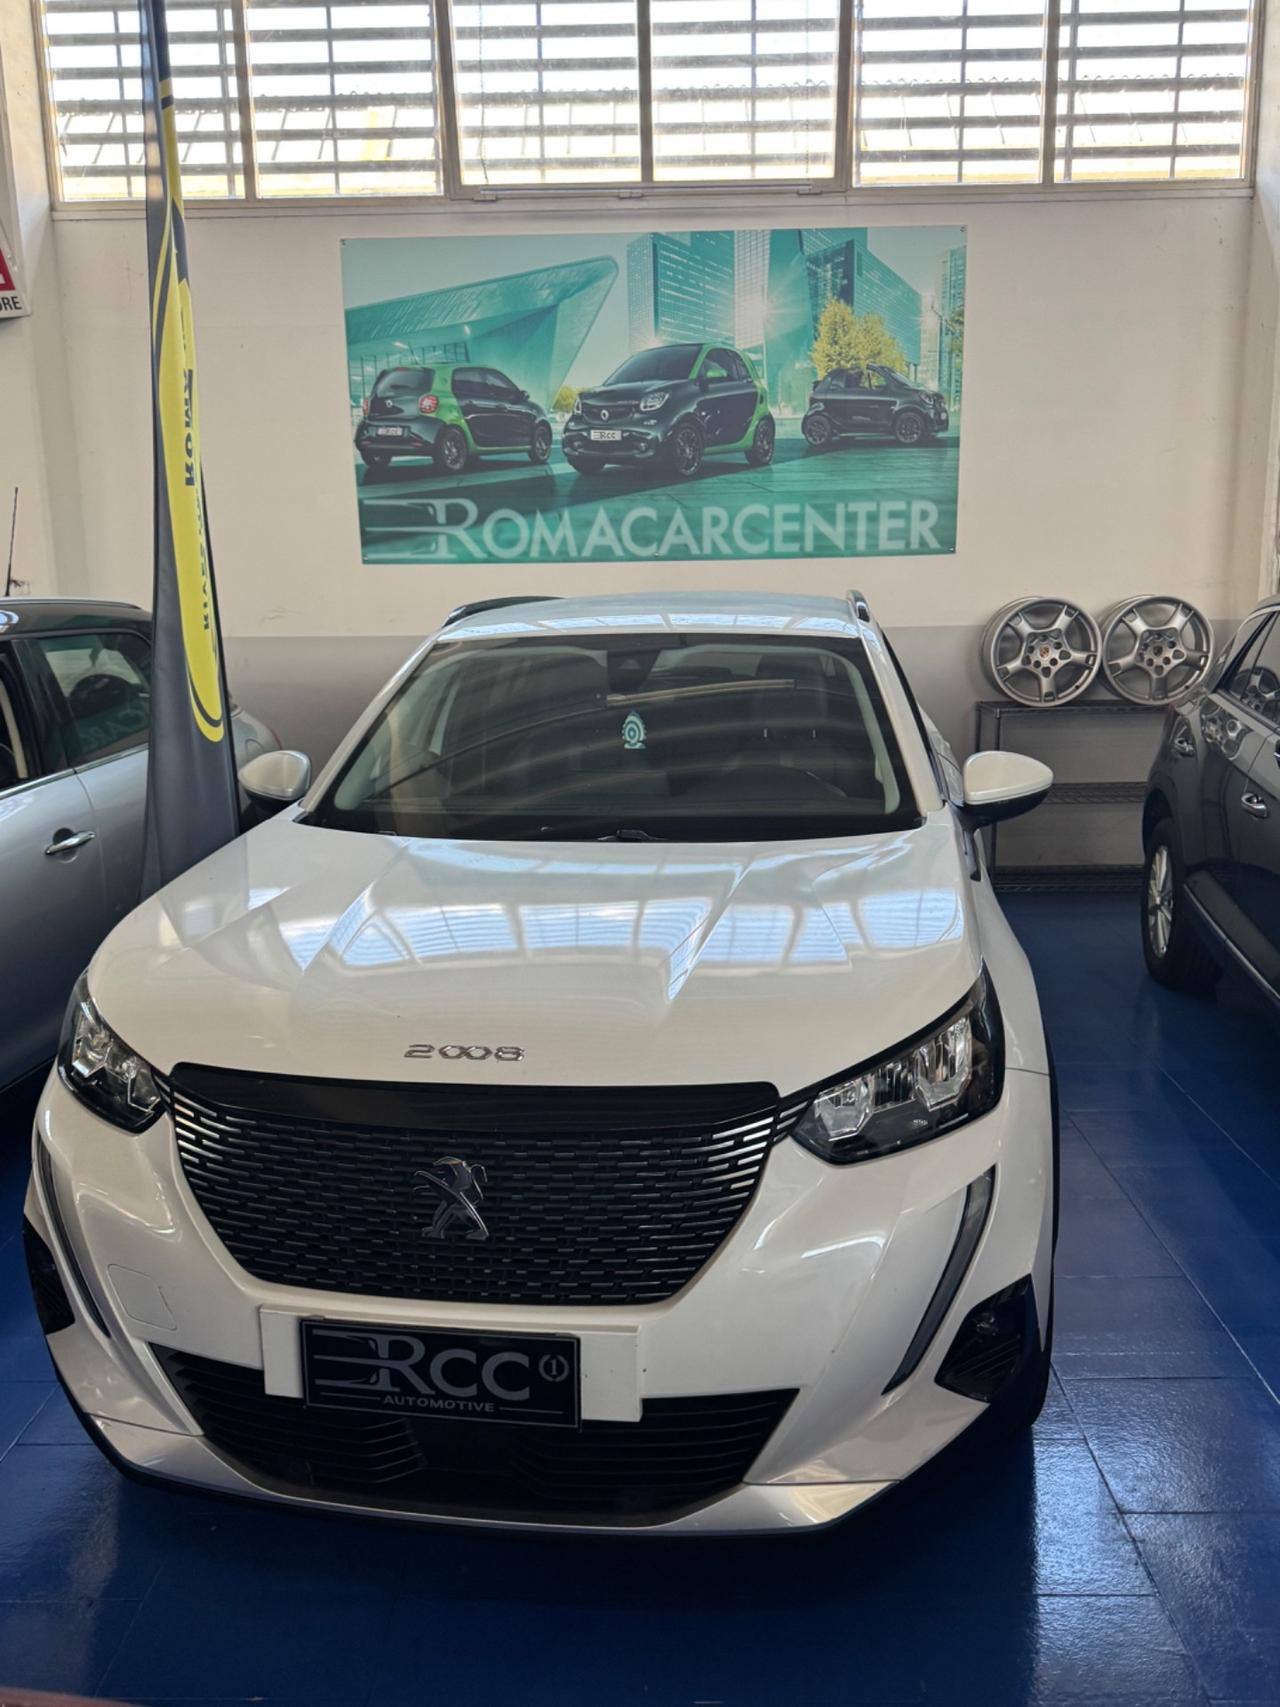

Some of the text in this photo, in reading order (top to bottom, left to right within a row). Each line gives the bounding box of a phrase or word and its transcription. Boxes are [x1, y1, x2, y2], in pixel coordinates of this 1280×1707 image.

[363, 498, 940, 561] ROMACARCENTER
[403, 1043, 525, 1062] 2008
[313, 1328, 531, 1402] RCC
[383, 1394, 496, 1413] AUTOMOTIVE
